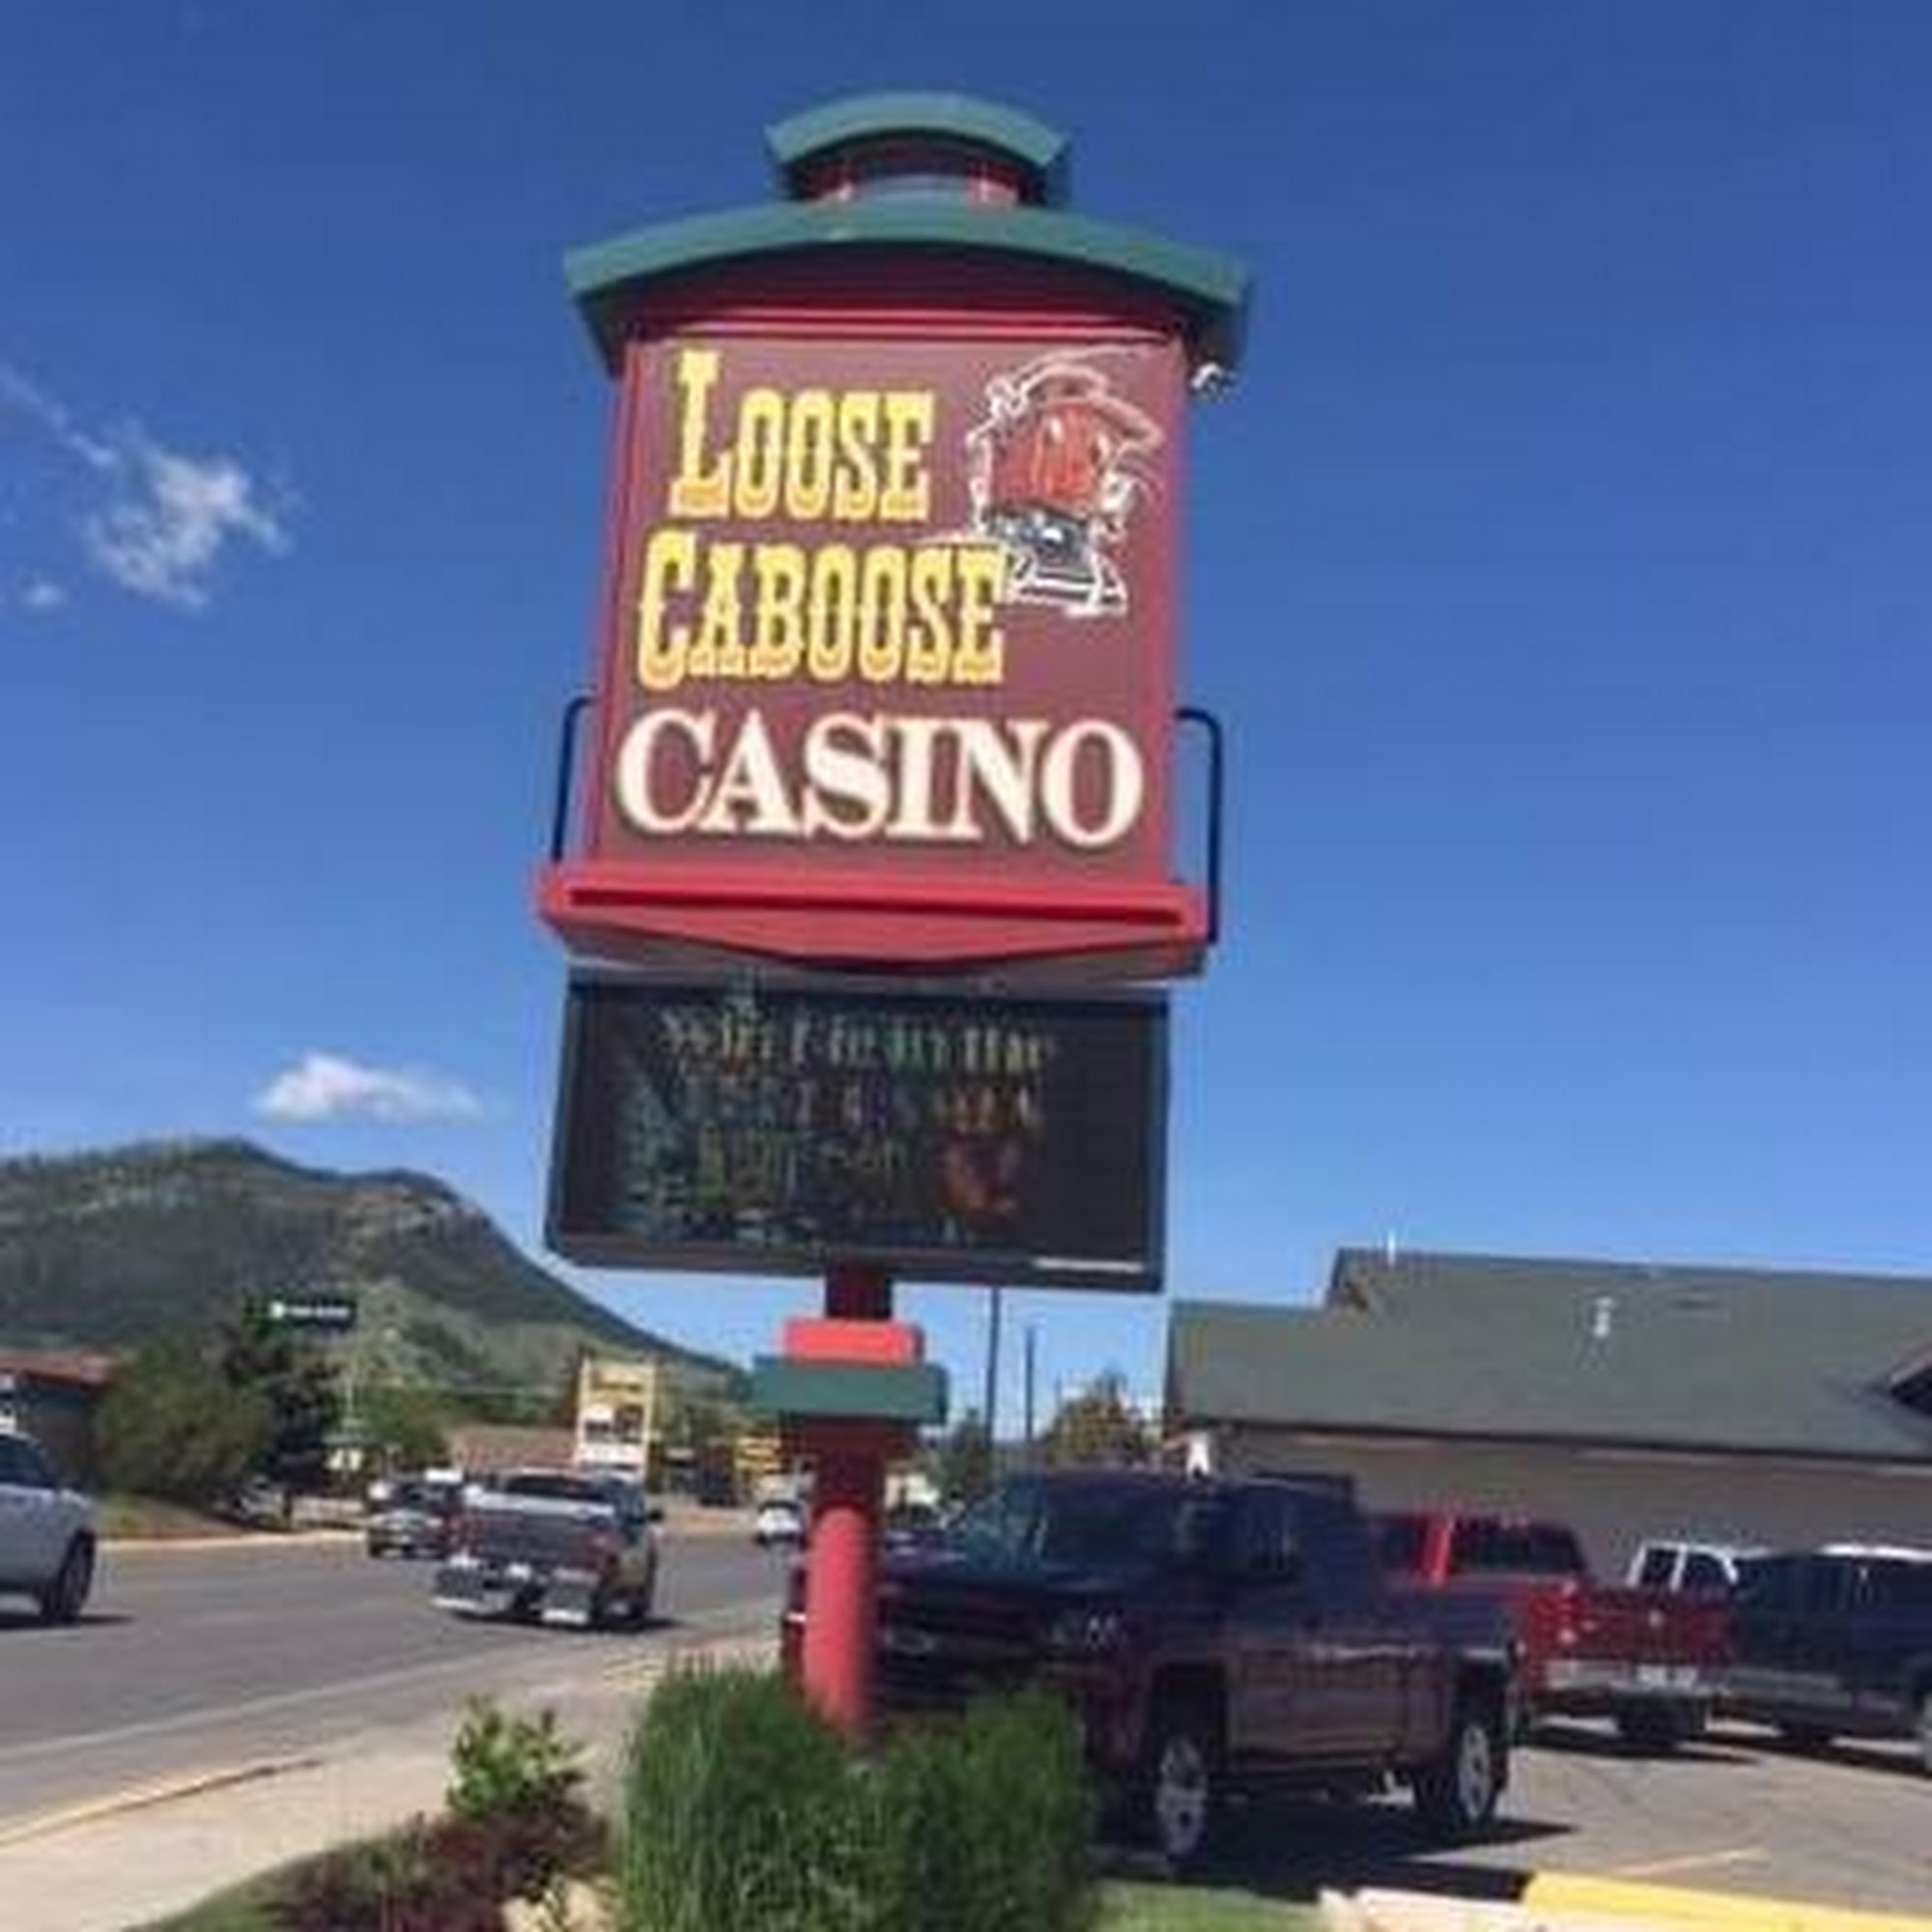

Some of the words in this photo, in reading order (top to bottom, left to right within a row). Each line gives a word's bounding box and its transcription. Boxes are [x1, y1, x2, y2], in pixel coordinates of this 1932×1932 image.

[668, 350, 935, 520] LOOSE
[639, 529, 1006, 690] CABOOSE
[616, 709, 1144, 846] CASINO
